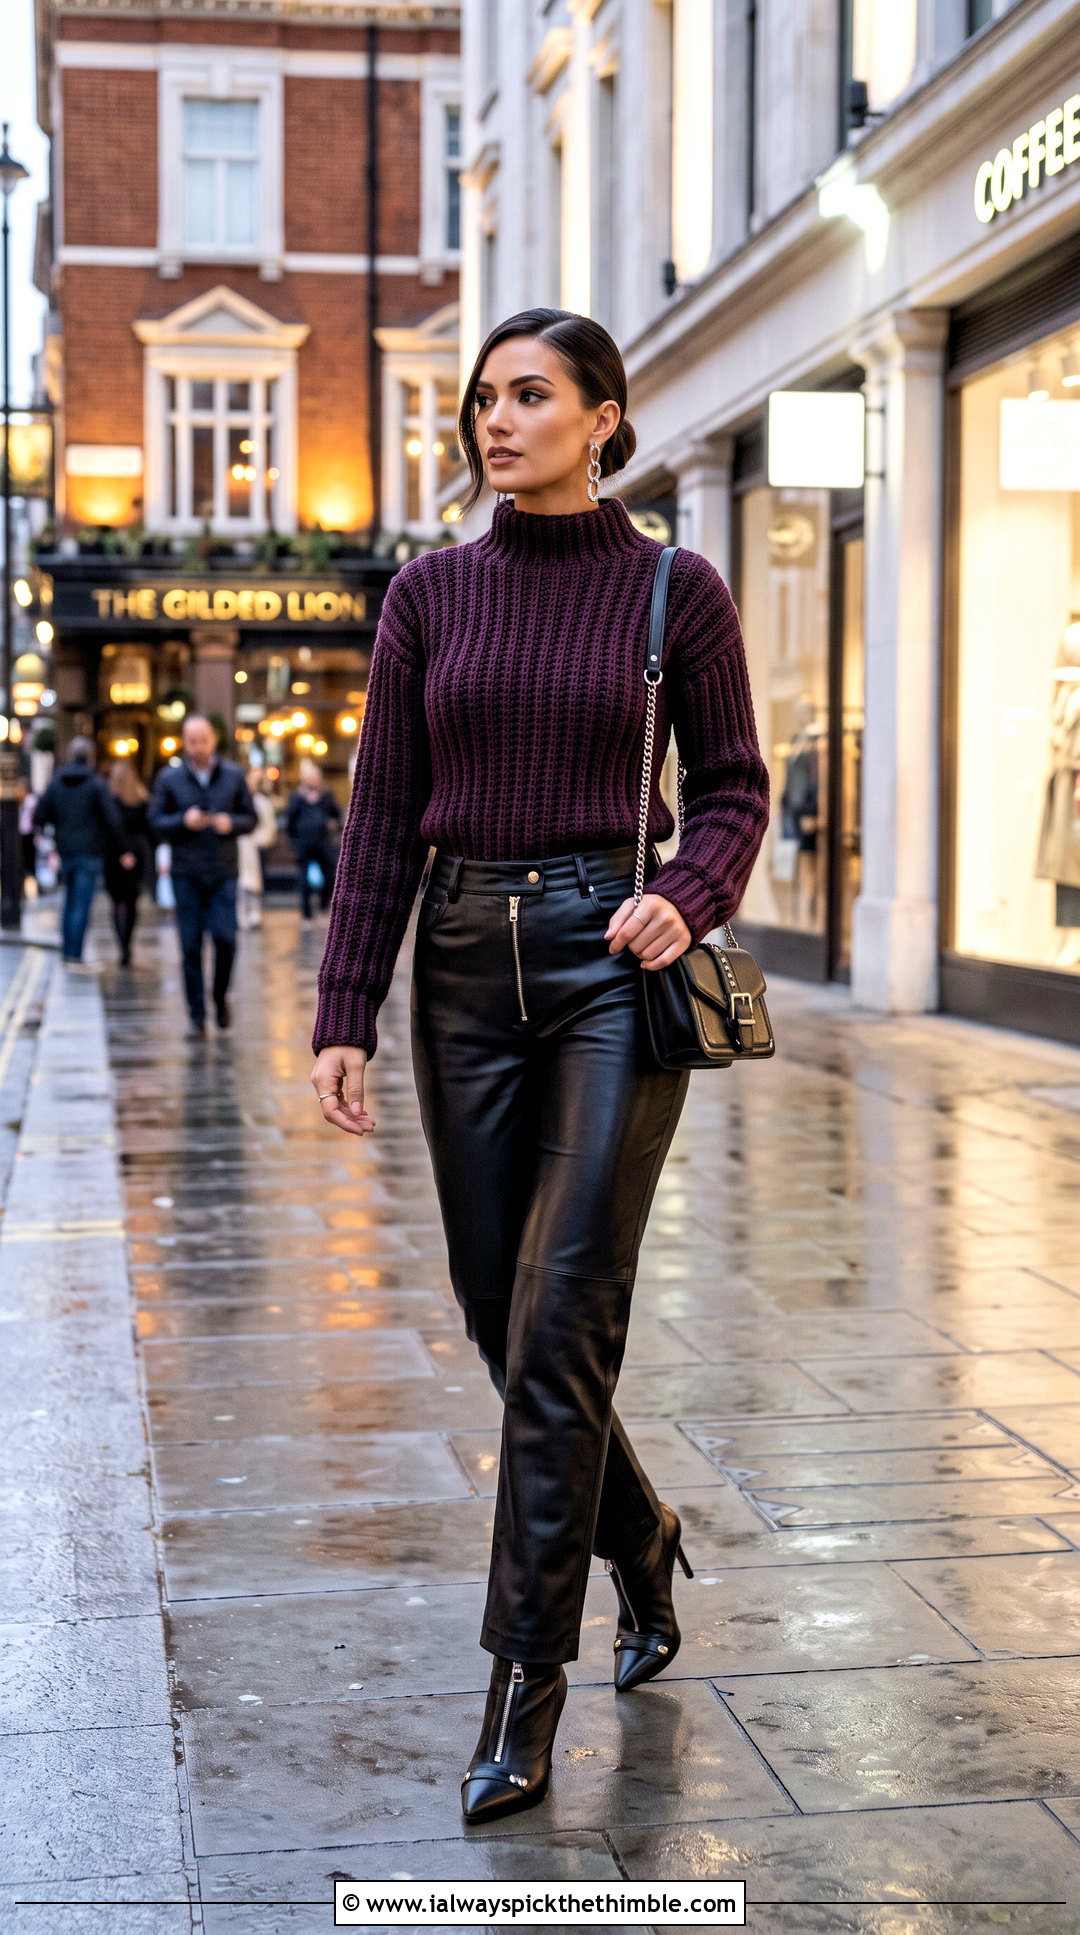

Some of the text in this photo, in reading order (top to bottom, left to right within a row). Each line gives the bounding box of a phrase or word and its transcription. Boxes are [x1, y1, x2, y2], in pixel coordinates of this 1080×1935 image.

[974, 93, 1080, 223] COFFEE
[93, 589, 367, 621] THE GILDED LION
